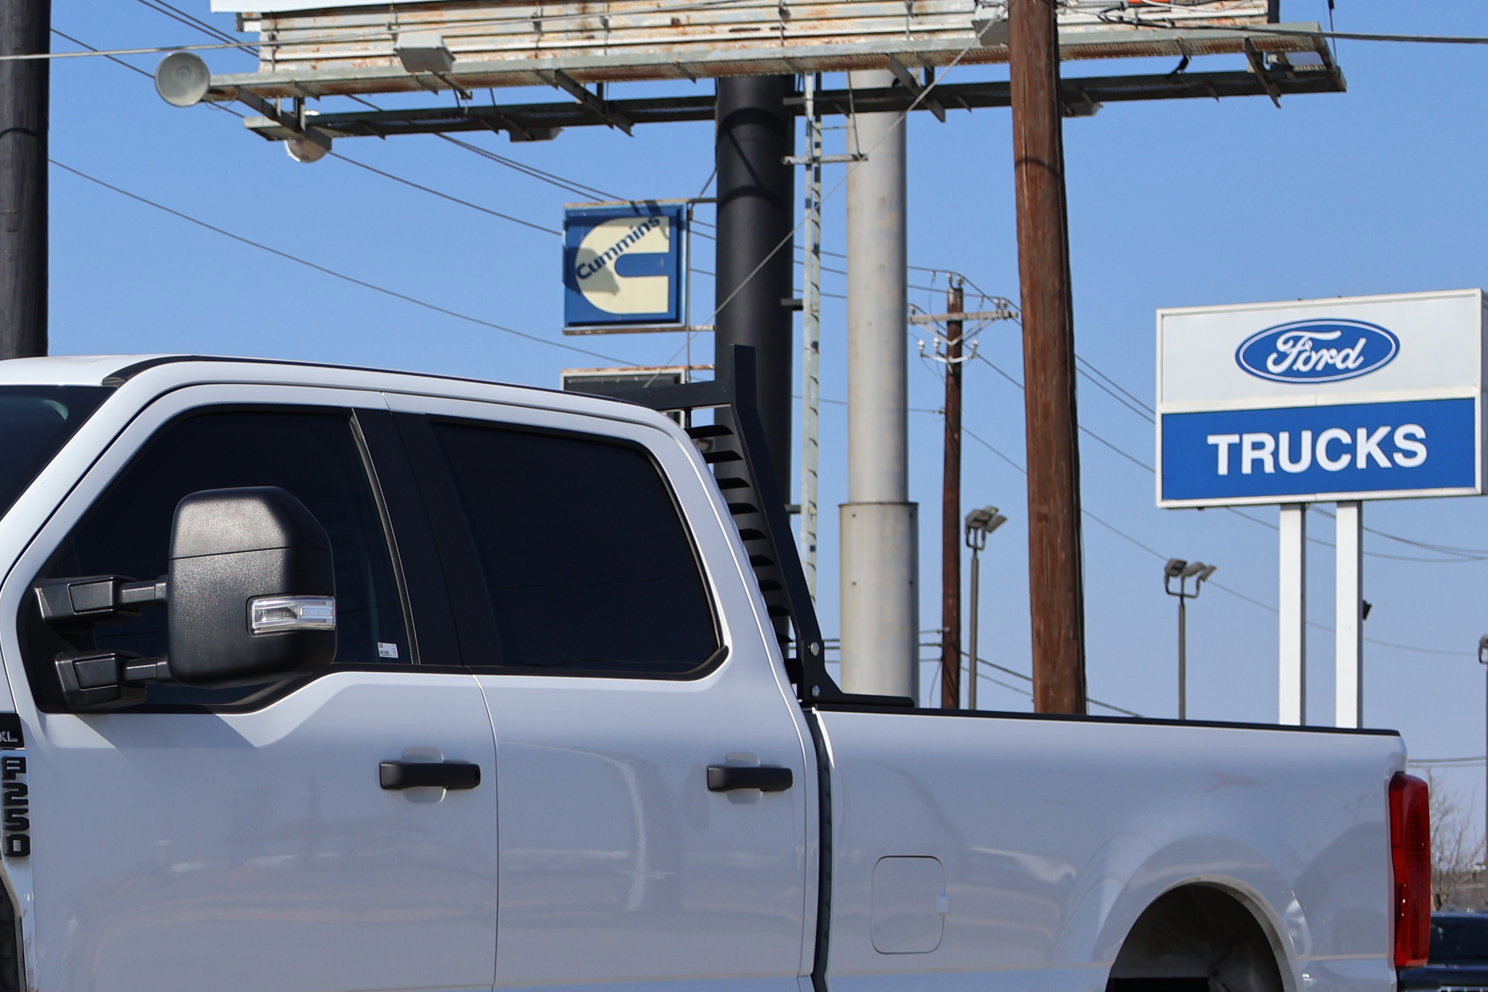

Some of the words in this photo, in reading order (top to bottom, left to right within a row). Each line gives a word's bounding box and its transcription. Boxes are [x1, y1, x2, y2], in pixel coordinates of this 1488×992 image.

[576, 217, 661, 280] Cummins
[1266, 330, 1368, 375] Ford
[1207, 424, 1428, 476] TRUCKS
